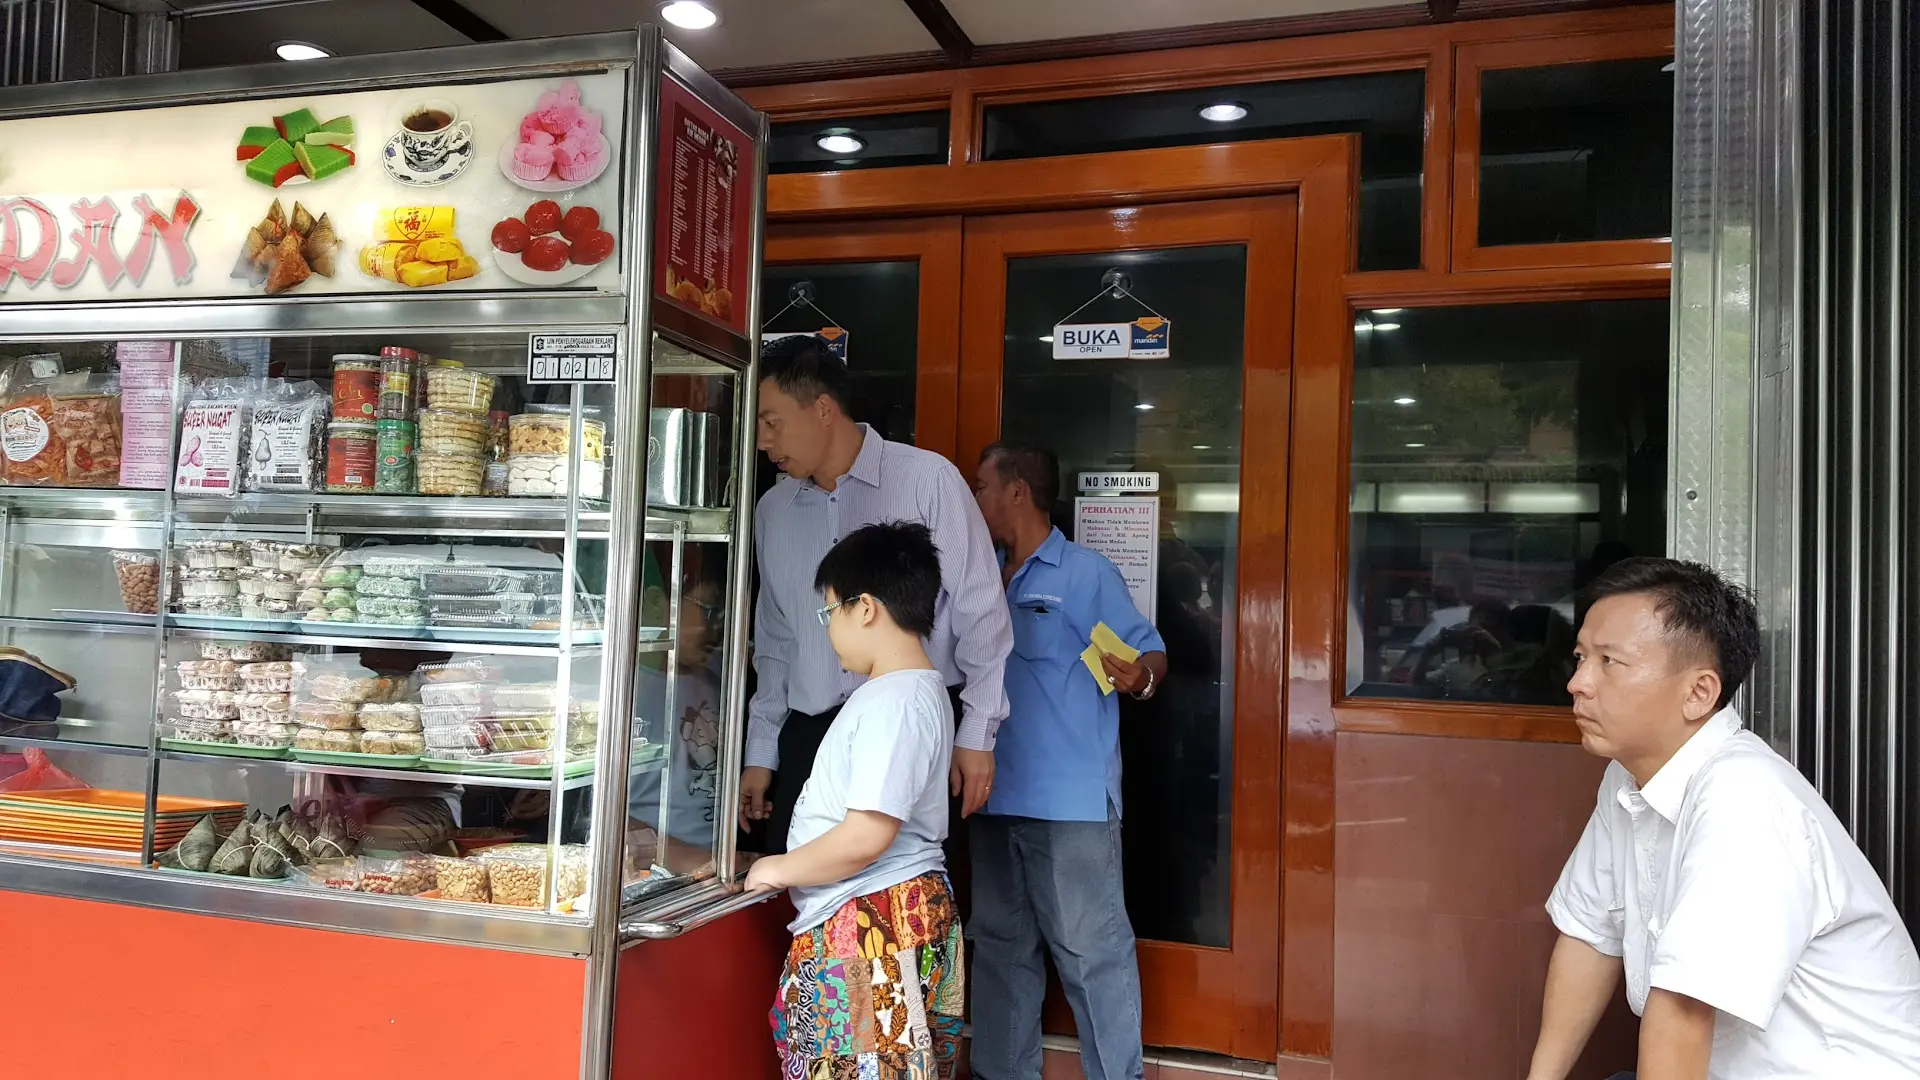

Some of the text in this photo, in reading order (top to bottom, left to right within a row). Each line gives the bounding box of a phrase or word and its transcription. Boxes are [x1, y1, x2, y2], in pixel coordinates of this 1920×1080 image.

[1063, 329, 1121, 345] BUKA
[1134, 336, 1158, 344] mandiri
[184, 410, 206, 430] SUPER
[206, 410, 232, 430] NUGAT
[1085, 476, 1152, 487] NO SMOKING
[1081, 506, 1135, 514] PERHATIAN
